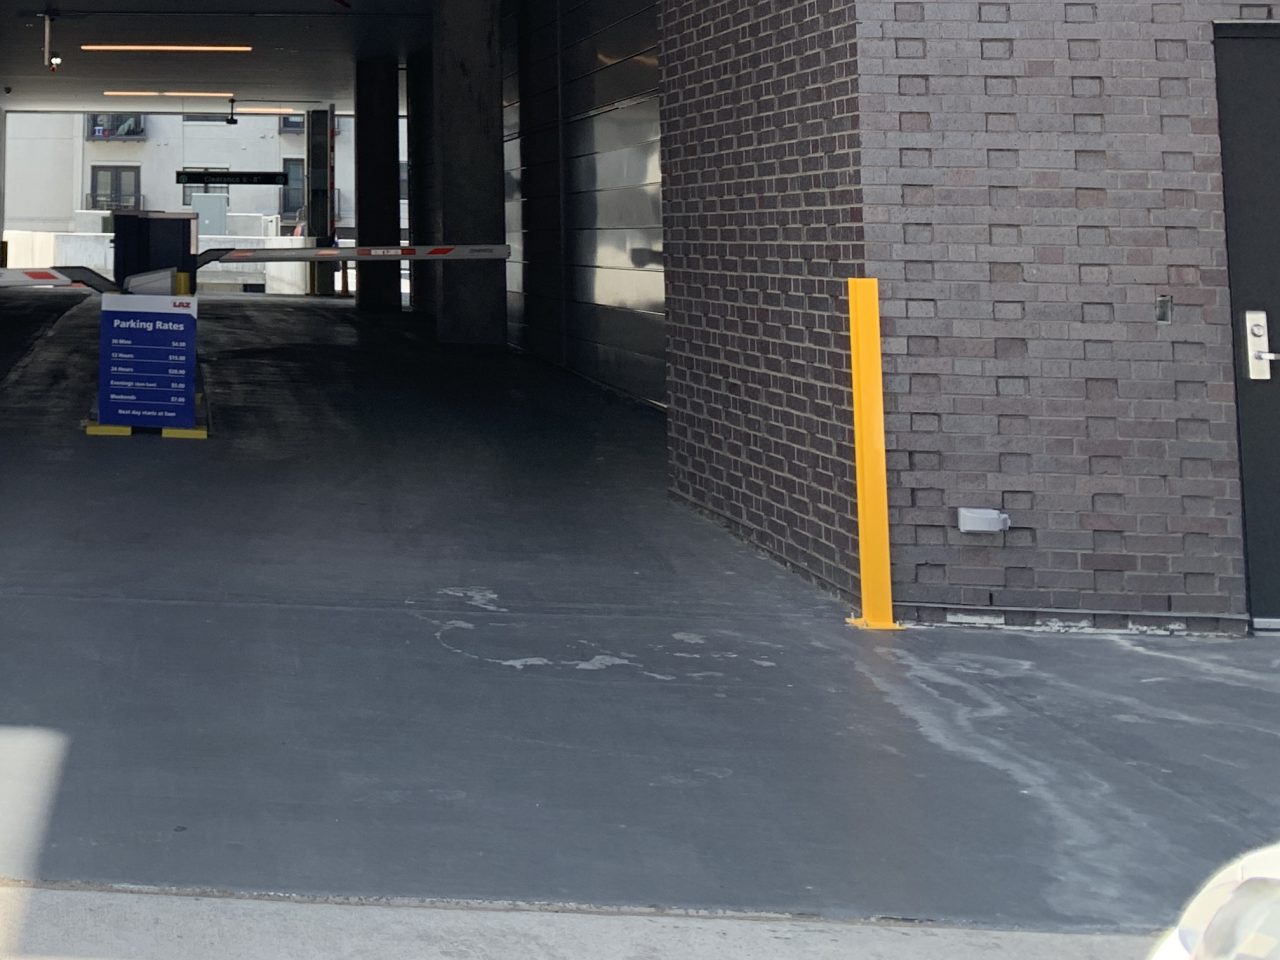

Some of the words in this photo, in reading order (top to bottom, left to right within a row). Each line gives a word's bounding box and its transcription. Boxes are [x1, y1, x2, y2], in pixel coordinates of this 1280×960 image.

[172, 301, 191, 309] LAZ
[113, 319, 153, 331] Parking
[155, 321, 185, 331] Rates
